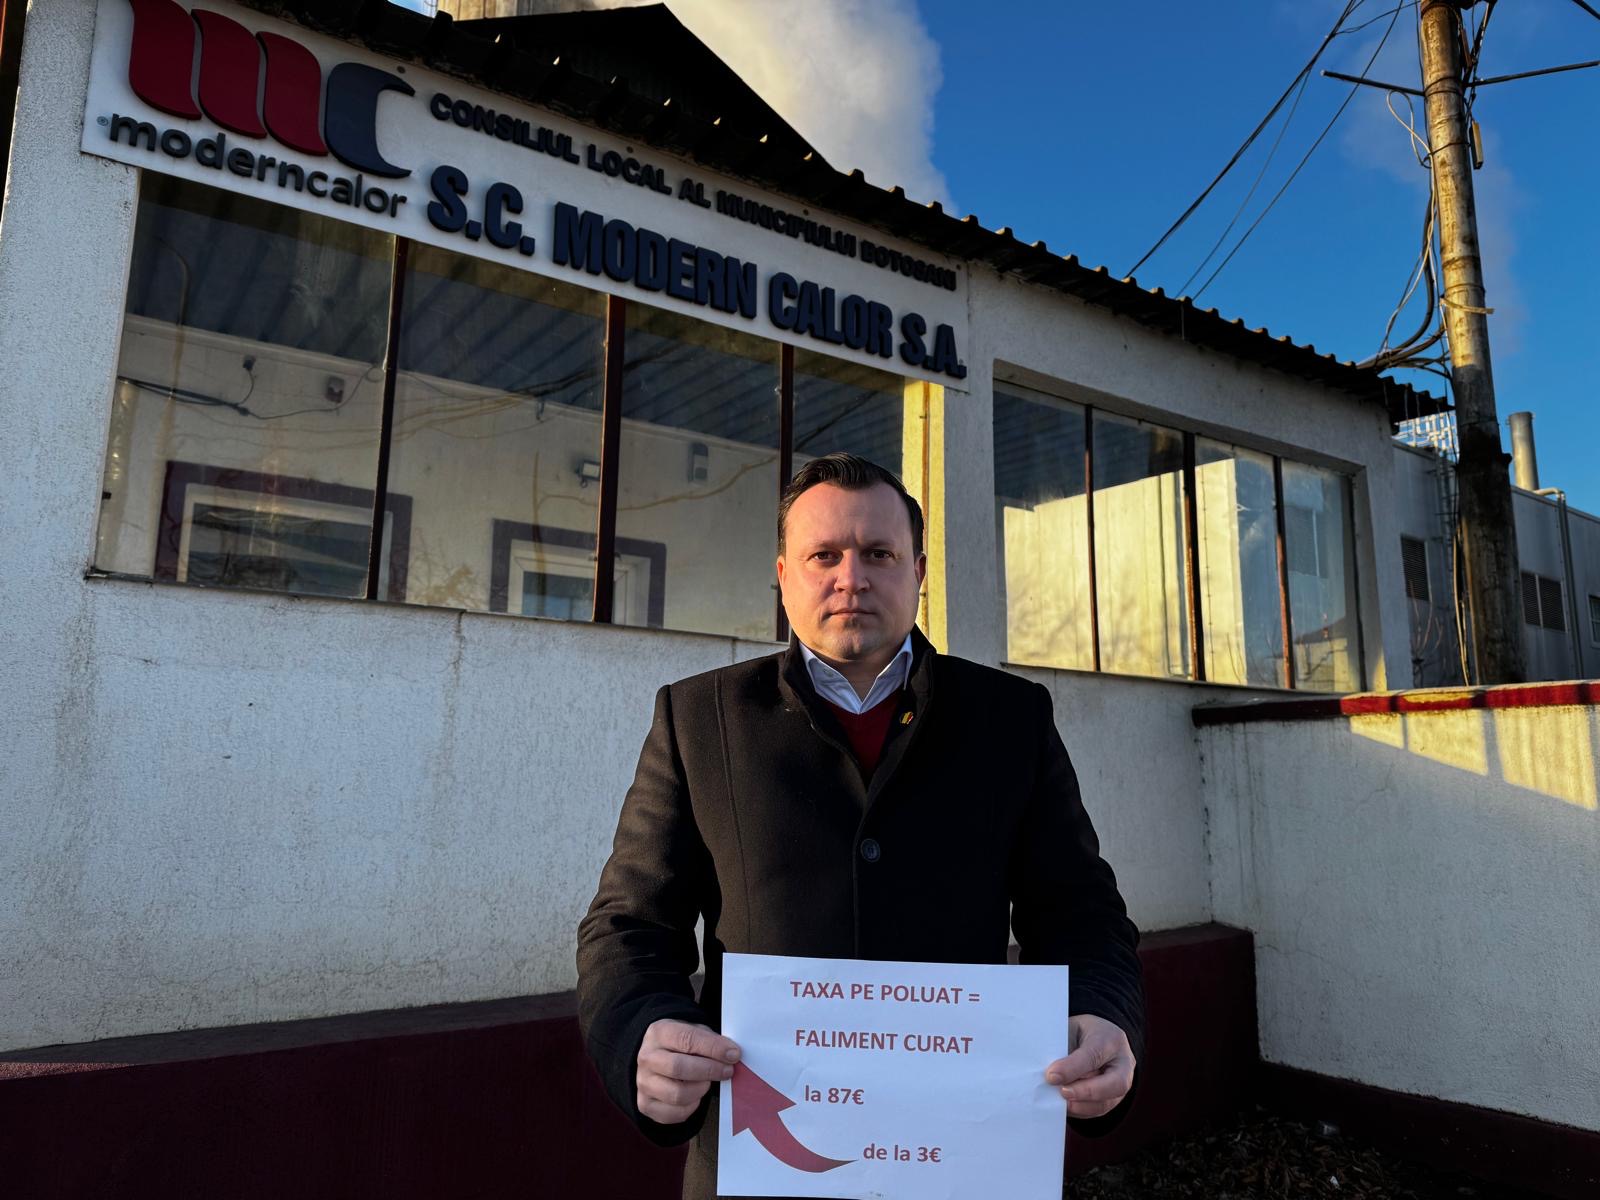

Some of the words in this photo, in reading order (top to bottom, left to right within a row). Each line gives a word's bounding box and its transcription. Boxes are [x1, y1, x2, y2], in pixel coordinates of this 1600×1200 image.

[109, 112, 408, 218] moderncalor
[430, 92, 580, 165] CONSILIUL
[587, 143, 672, 195] LOCAL
[678, 178, 711, 209] AL
[716, 189, 856, 258] MUNICIPIULUI
[860, 239, 957, 292] BOTOSANI
[427, 164, 536, 257] S.C.
[552, 201, 757, 320] MODERN
[768, 271, 893, 359] CALOR
[899, 312, 967, 380] S.A.
[790, 981, 844, 1000] TAXA
[851, 983, 874, 1000] PE
[881, 984, 963, 1005] POLUAT
[968, 991, 980, 1003] =
[795, 1029, 898, 1051] FALIMENT
[903, 1034, 973, 1054] CURAT
[804, 1085, 822, 1103] la
[827, 1087, 865, 1105] 87€
[863, 1143, 888, 1161] de
[893, 1145, 911, 1161] la
[917, 1146, 942, 1163] 3€
